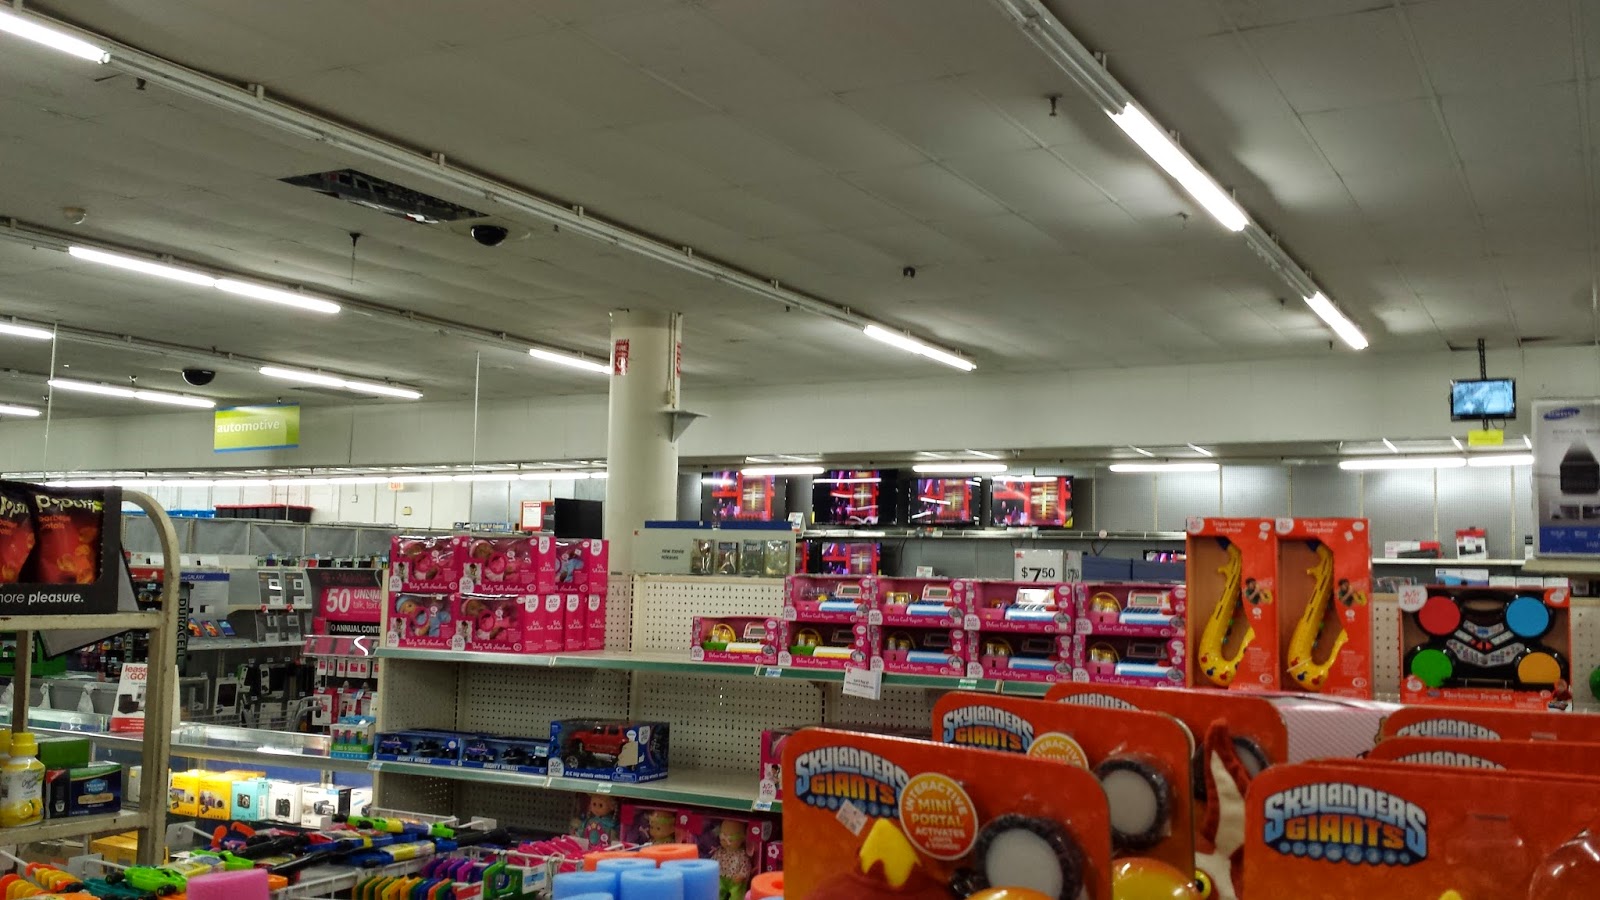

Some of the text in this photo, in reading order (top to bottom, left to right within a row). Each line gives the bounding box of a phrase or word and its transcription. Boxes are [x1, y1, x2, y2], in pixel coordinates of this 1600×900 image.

[217, 419, 280, 433] automotive
[28, 591, 84, 605] pleasure.
[353, 588, 382, 600] UNLIM
[177, 598, 187, 659] DURACELL
[336, 624, 361, 633] ANNUAL
[361, 625, 381, 635] CONT
[943, 705, 1034, 746] SKYLANDERS
[956, 726, 1022, 748] GIANTS
[795, 747, 910, 796] SKYLANDERS
[811, 773, 895, 805] GIANTS
[906, 781, 968, 816] INTERACTIVE
[917, 798, 953, 812] MINI
[911, 813, 965, 827] PORTAL
[1264, 783, 1427, 858] SKYLANDERS
[1286, 815, 1404, 849] GIANTS
